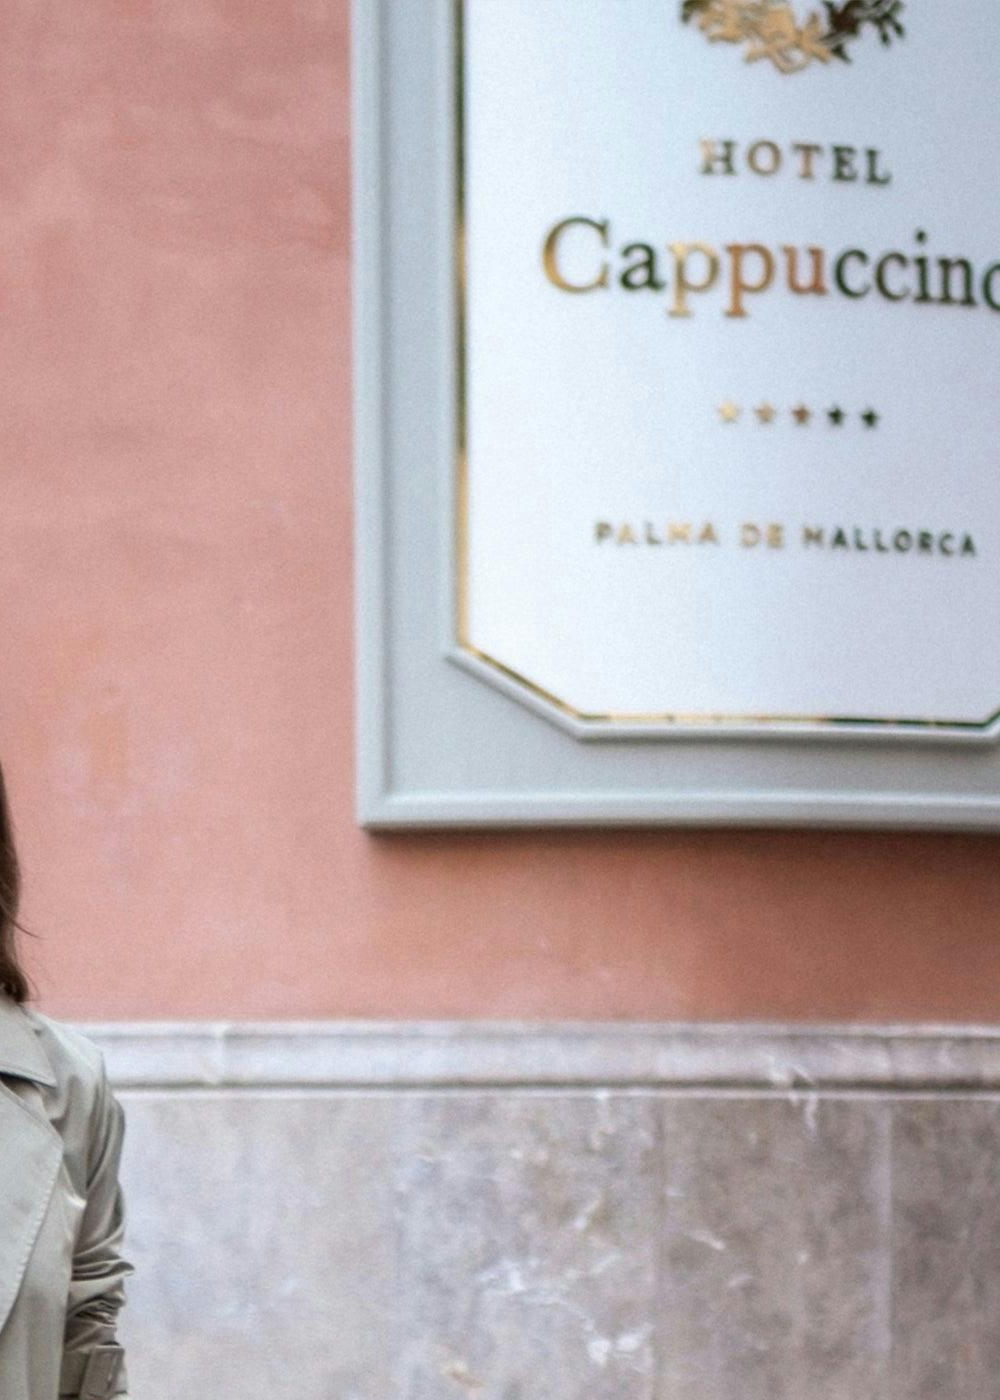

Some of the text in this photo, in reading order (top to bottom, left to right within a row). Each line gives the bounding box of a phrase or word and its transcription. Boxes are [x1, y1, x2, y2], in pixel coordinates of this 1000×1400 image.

[700, 139, 892, 186] HOTEL
[594, 520, 977, 556] PALMA DE MALLORCA
